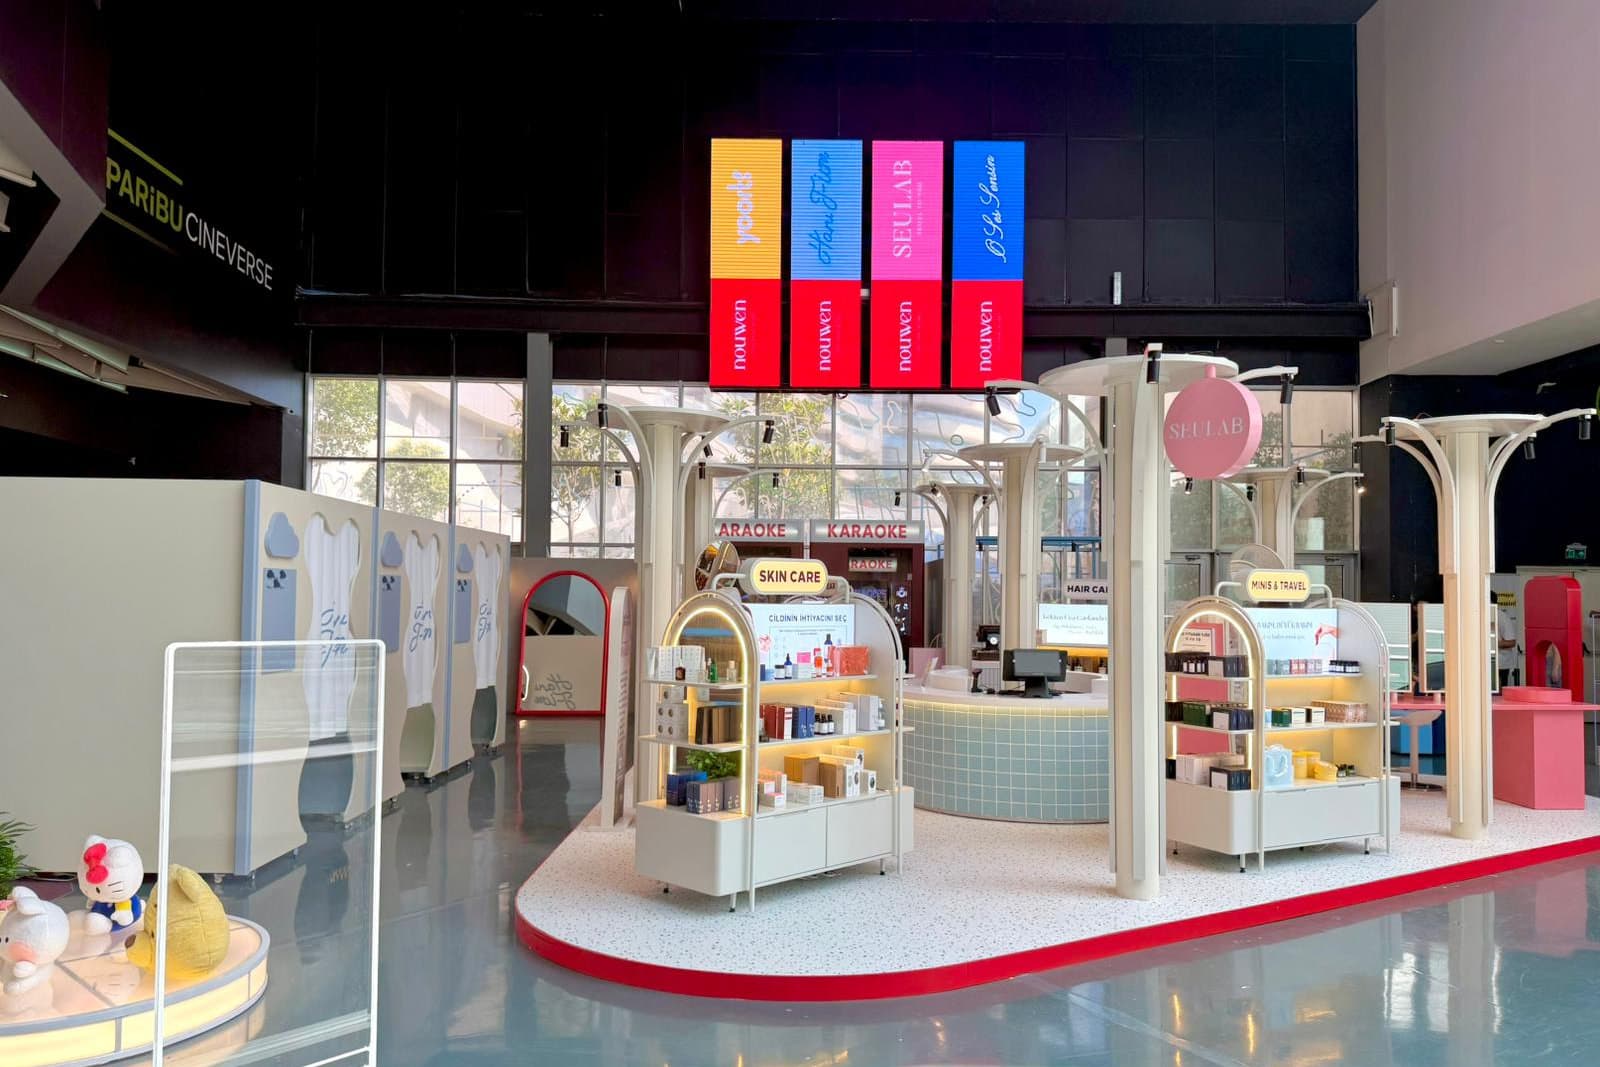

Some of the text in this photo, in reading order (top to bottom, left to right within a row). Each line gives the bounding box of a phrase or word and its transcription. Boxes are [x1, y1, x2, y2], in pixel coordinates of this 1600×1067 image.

[892, 159, 913, 258] SEULAB
[979, 154, 1000, 208] Sensin
[185, 212, 273, 291] CINEVERSE
[734, 299, 747, 370] nouwen
[819, 300, 832, 371] nouwen
[899, 301, 912, 372] nouwen
[980, 300, 993, 372] nouwen
[1169, 417, 1244, 439] SEULAB
[827, 523, 908, 539] KARAOKE
[759, 569, 821, 583] SKIN CARE
[1067, 585, 1090, 593] HAIR
[1251, 580, 1307, 591] MINIS & TRAVEL
